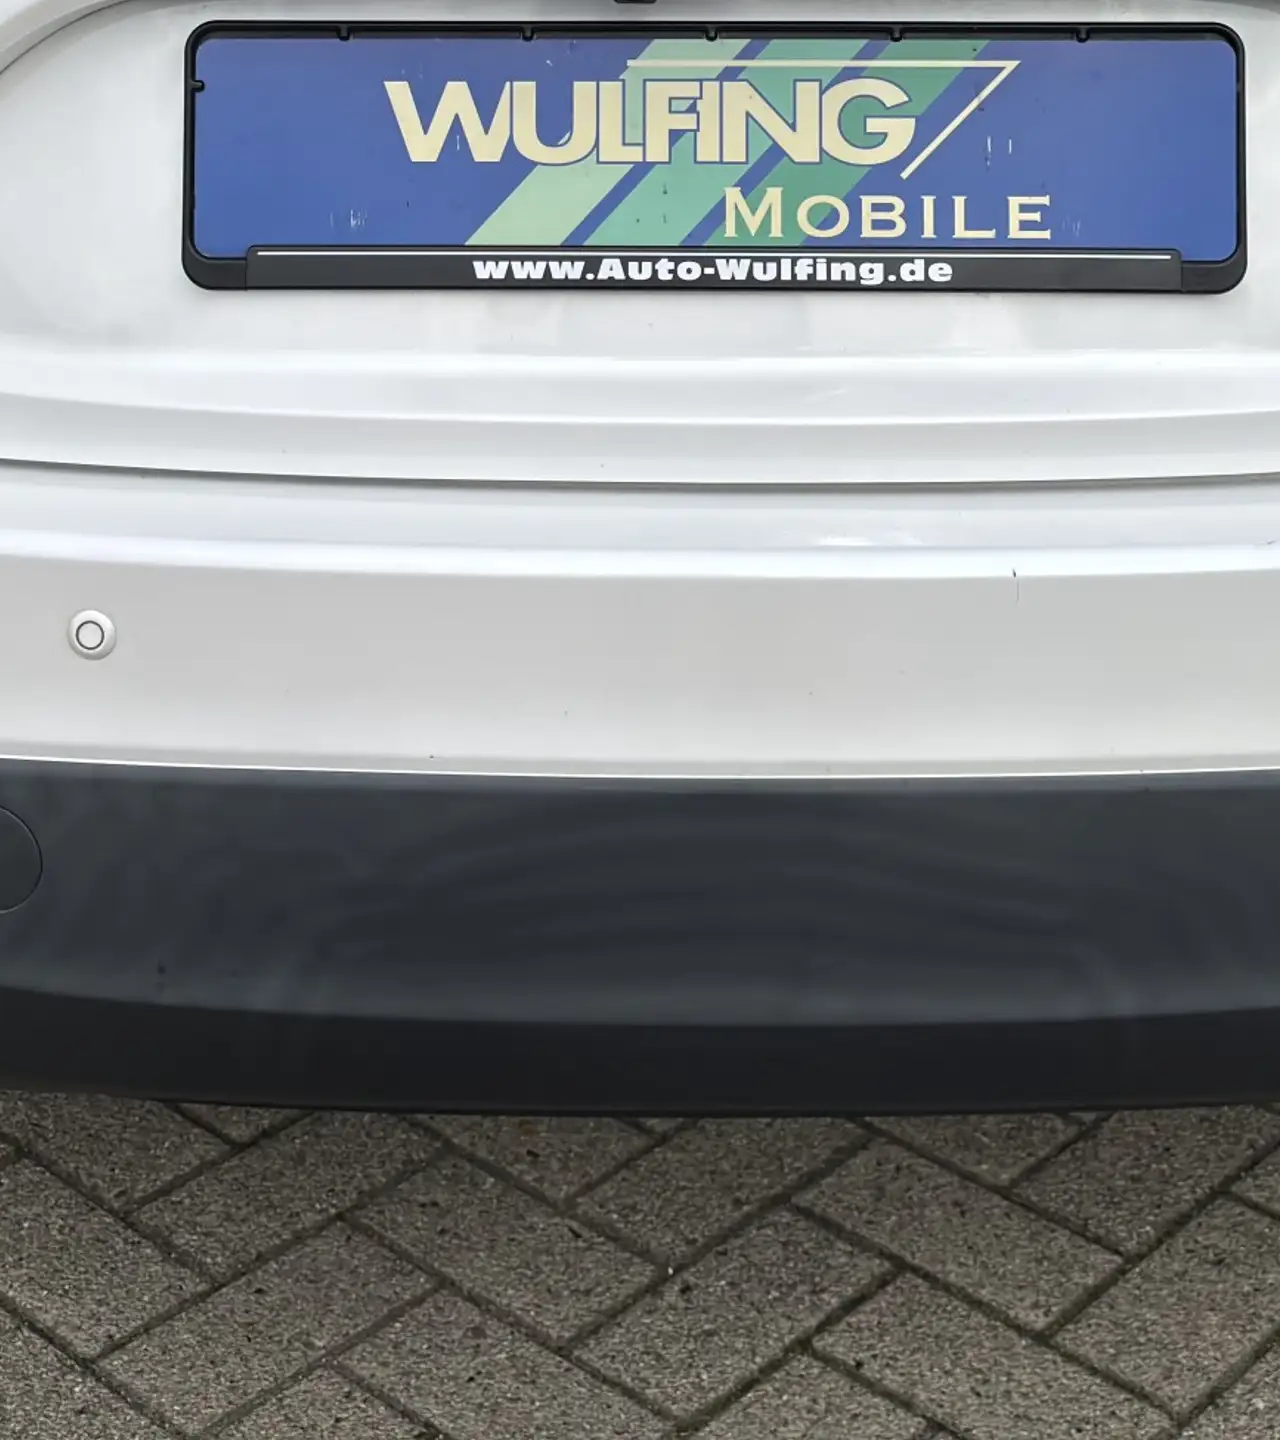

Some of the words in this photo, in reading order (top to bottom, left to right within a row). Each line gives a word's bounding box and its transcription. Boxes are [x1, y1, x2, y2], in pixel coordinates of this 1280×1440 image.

[383, 76, 917, 166] WULFING
[723, 186, 1052, 240] MOBILE
[472, 257, 953, 286] www.Auto-Wulfing.de
